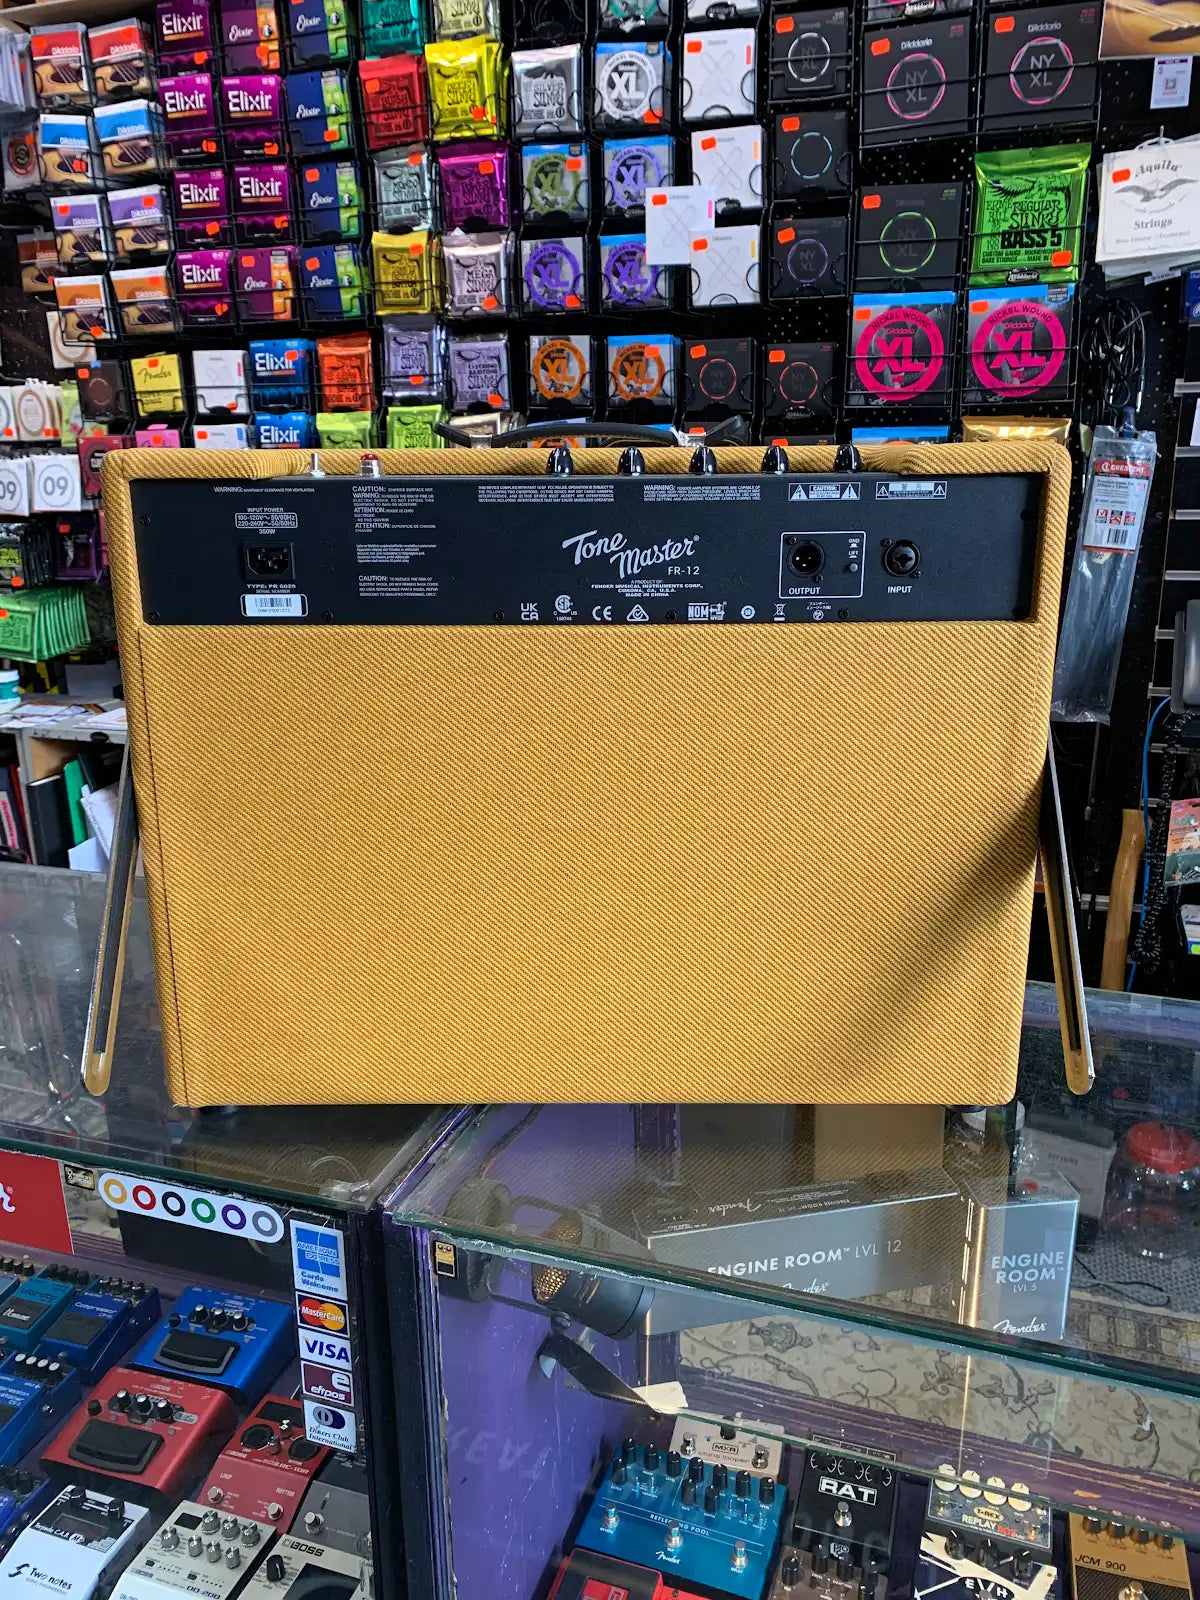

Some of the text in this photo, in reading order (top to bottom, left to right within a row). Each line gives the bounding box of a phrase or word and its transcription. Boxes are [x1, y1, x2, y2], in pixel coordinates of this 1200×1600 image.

[162, 12, 204, 35] Elixir
[1027, 22, 1061, 33] D'Addario
[901, 37, 933, 51] D'Addario
[1031, 54, 1055, 69] NY
[611, 71, 645, 99] XL
[905, 70, 928, 87] NY
[1030, 72, 1053, 88] XL
[165, 90, 207, 113] Elixir
[228, 90, 272, 113] Elixir
[905, 90, 927, 103] XL
[620, 165, 651, 189] XL
[1135, 159, 1180, 178] Aquila
[240, 177, 283, 203] Elixir
[538, 172, 570, 197] XL
[180, 183, 220, 206] Elixir
[1012, 199, 1064, 213] REGULAR
[1008, 211, 1059, 230] SLINKY
[1134, 217, 1173, 231] Strings
[1001, 230, 1062, 250] BASS 5
[183, 264, 221, 287] Elixir
[466, 269, 495, 281] MEGA
[538, 263, 570, 288] XL
[615, 261, 648, 286] XL
[801, 262, 815, 272] XL
[872, 311, 931, 330] NICKEL WOUND
[989, 304, 1052, 325] NICKEL WOUND
[1004, 321, 1035, 330] D'Addario
[872, 336, 925, 373] XL
[990, 330, 1046, 369] XL
[137, 366, 172, 384] Fender
[543, 358, 576, 383] XL
[623, 361, 654, 385] XL
[260, 426, 300, 445] Elixir
[44, 476, 69, 497] 09
[562, 529, 627, 566] Tone
[610, 536, 698, 579] Master
[668, 566, 700, 576] FR-12
[788, 587, 821, 595] OUTPUT
[887, 585, 913, 593] INPUT
[521, 603, 537, 611] UK
[592, 605, 612, 621] CE
[688, 605, 708, 618] NOM
[521, 612, 539, 621] CA
[708, 1199, 762, 1218] Fender
[296, 1241, 339, 1259] AMERICAN
[305, 1251, 341, 1266] EXPRESS
[785, 1251, 842, 1268] ROOM
[855, 1245, 878, 1260] LVL
[885, 1239, 902, 1254] 12
[991, 1252, 1064, 1270] ENGINE
[301, 1270, 324, 1282] Cards
[995, 1267, 1056, 1284] ROOM
[301, 1278, 339, 1293] Welcome
[1013, 1283, 1038, 1293] LVL 5
[75, 1302, 118, 1315] Compressor
[301, 1305, 345, 1324] MasterCard
[993, 1316, 1049, 1334] Fender
[304, 1337, 351, 1363] VISA
[310, 1385, 345, 1402] eftpos
[309, 1426, 350, 1443] Diners Club
[309, 1433, 355, 1451] International
[714, 1444, 737, 1454] MXR
[219, 1472, 233, 1480] LOOP
[279, 1463, 309, 1475] RC-10R
[821, 1479, 875, 1503] RAT
[690, 1525, 710, 1537] POOL
[962, 1515, 997, 1529] REPLAY
[289, 1539, 325, 1557] BOSS
[655, 1551, 681, 1566] Fender
[1074, 1554, 1127, 1573] JCM 900
[30, 1567, 47, 1581] Two
[48, 1574, 73, 1590] notes
